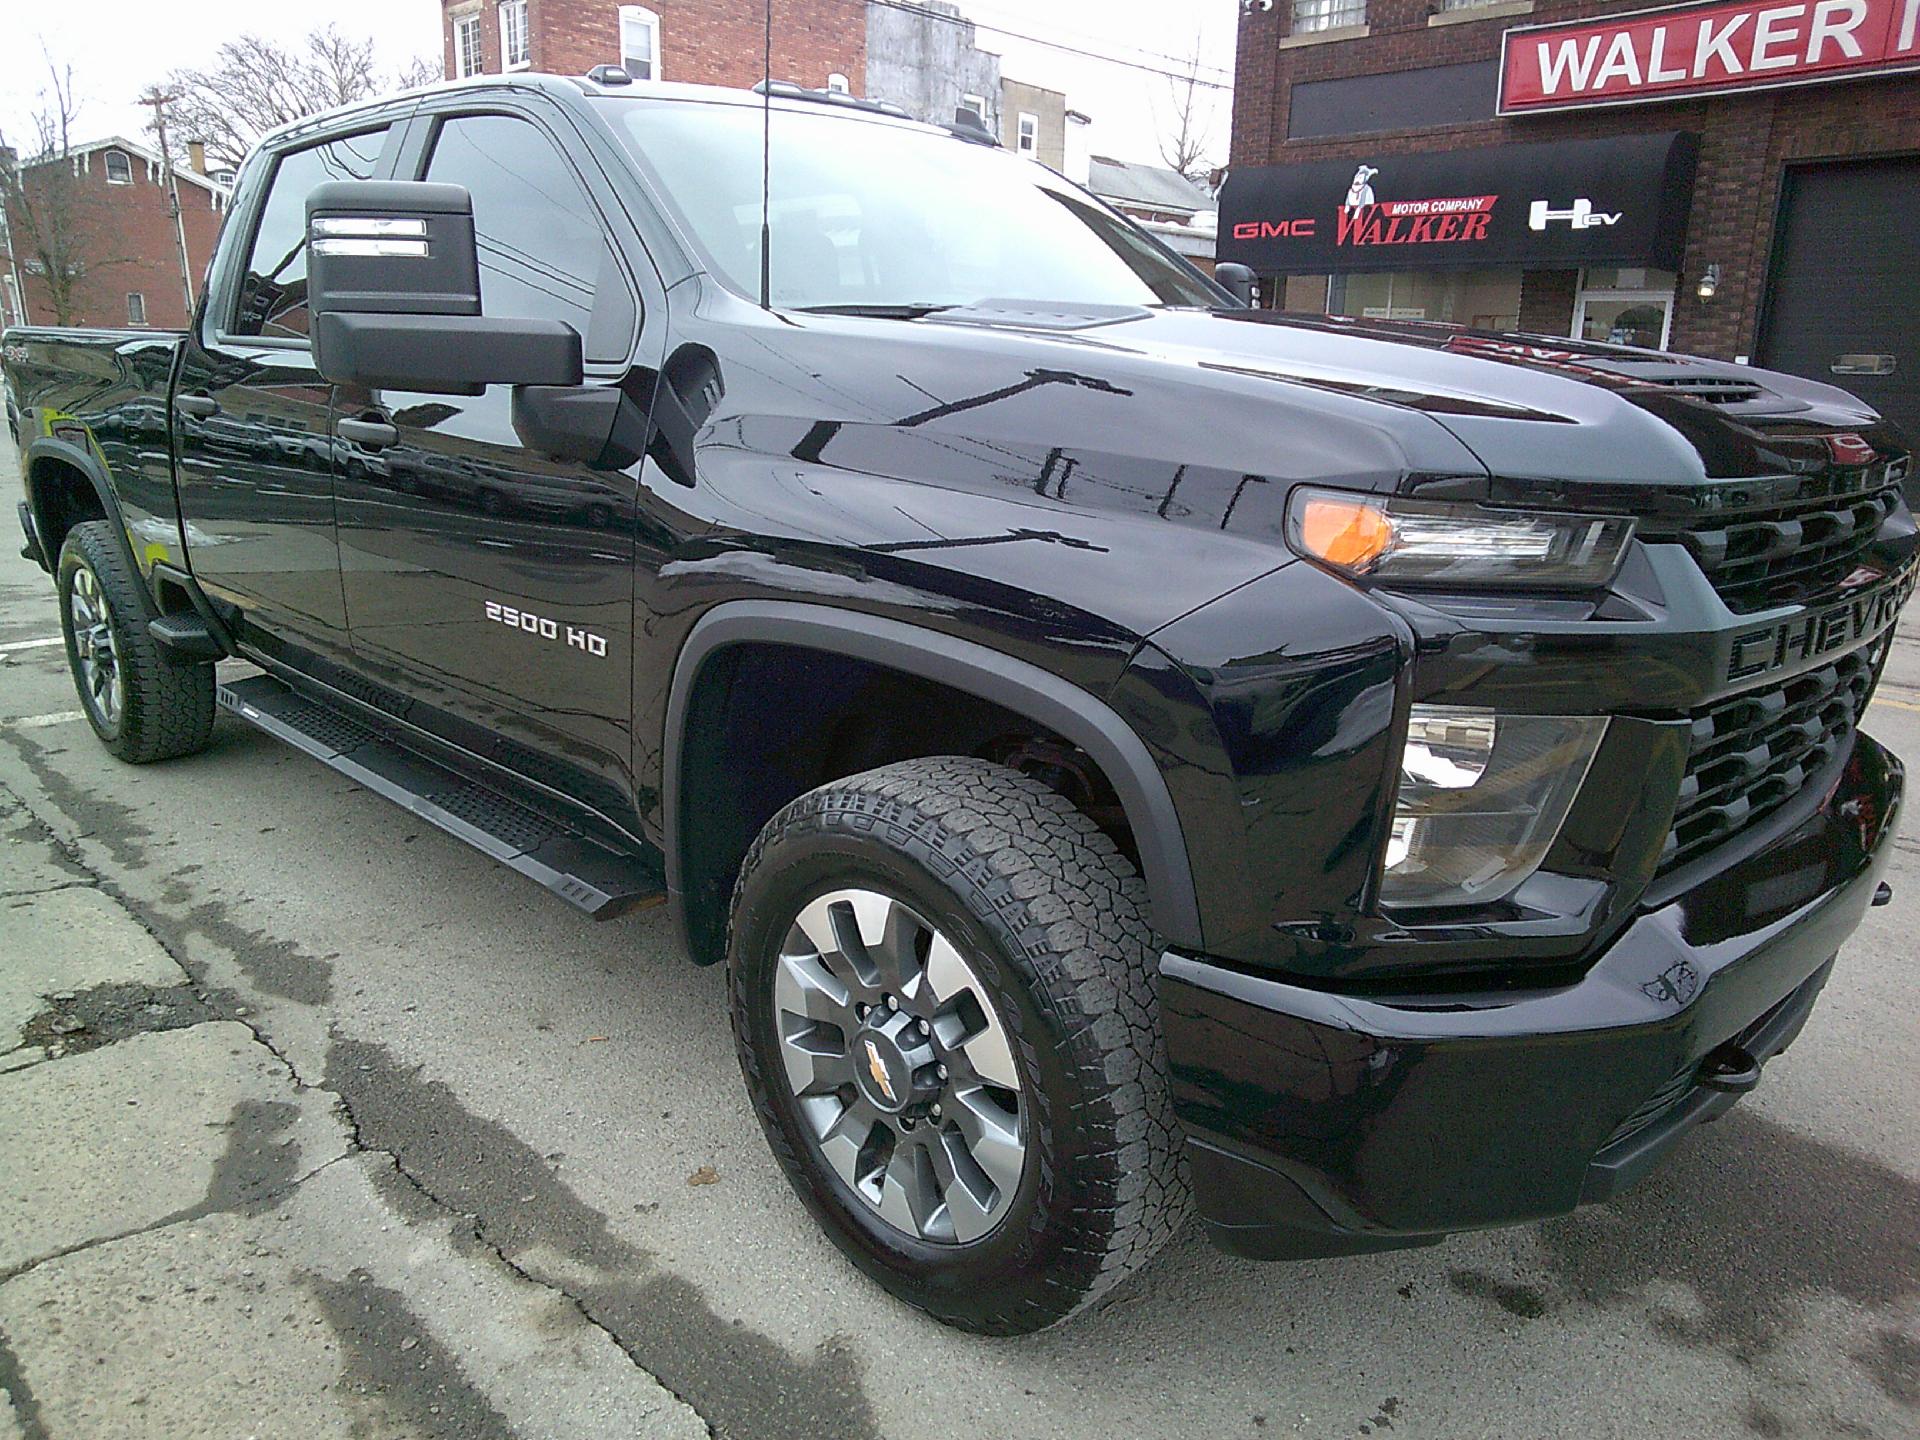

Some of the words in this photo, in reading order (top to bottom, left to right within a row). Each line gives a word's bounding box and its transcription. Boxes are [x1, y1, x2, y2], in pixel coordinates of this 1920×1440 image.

[1537, 0, 1867, 95] WALKER
[1337, 203, 1493, 246] WALKER
[1392, 202, 1429, 214] MOTOR
[1431, 198, 1484, 212] COMPANY
[1233, 219, 1316, 239] GMC
[485, 600, 558, 640] 2500
[567, 626, 607, 657] HD
